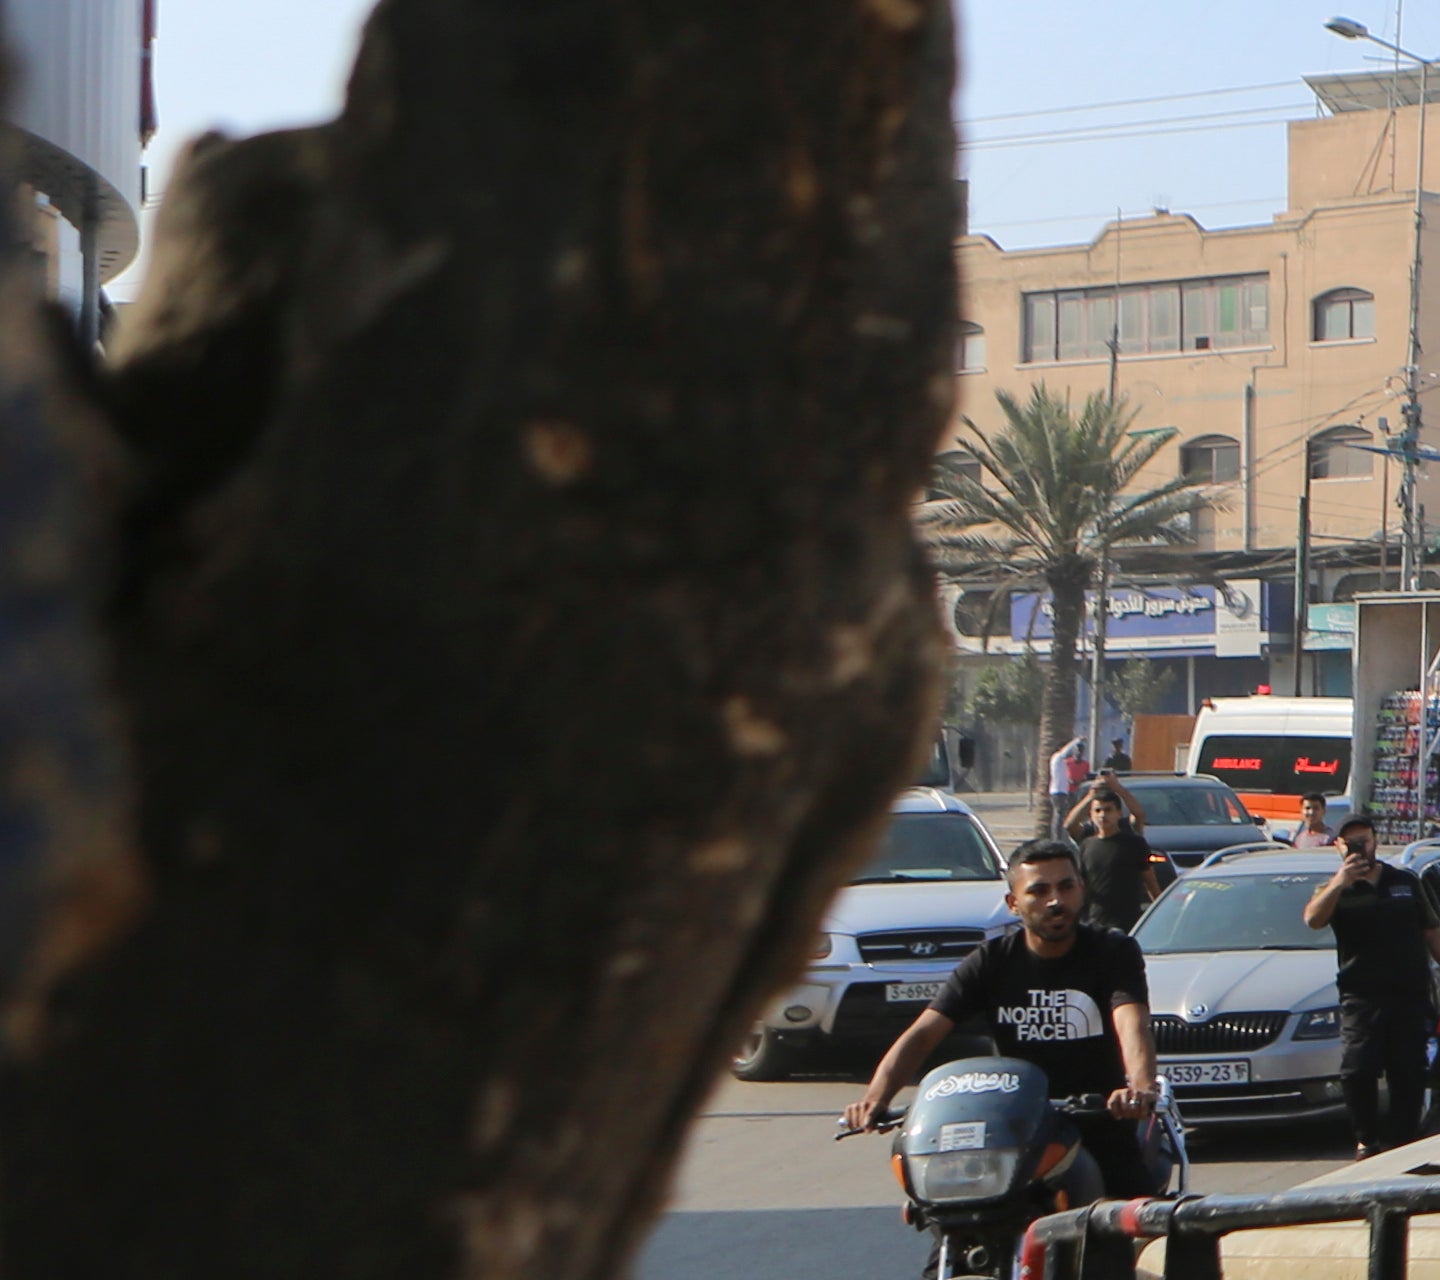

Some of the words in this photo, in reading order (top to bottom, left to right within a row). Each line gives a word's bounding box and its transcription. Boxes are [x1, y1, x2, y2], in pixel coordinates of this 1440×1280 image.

[1106, 594, 1144, 619] للأدوا
[1212, 757, 1263, 770] AMBULANCE
[1027, 989, 1066, 1007] THE
[998, 1006, 1066, 1024] NORTH
[1017, 1023, 1067, 1041] FACE
